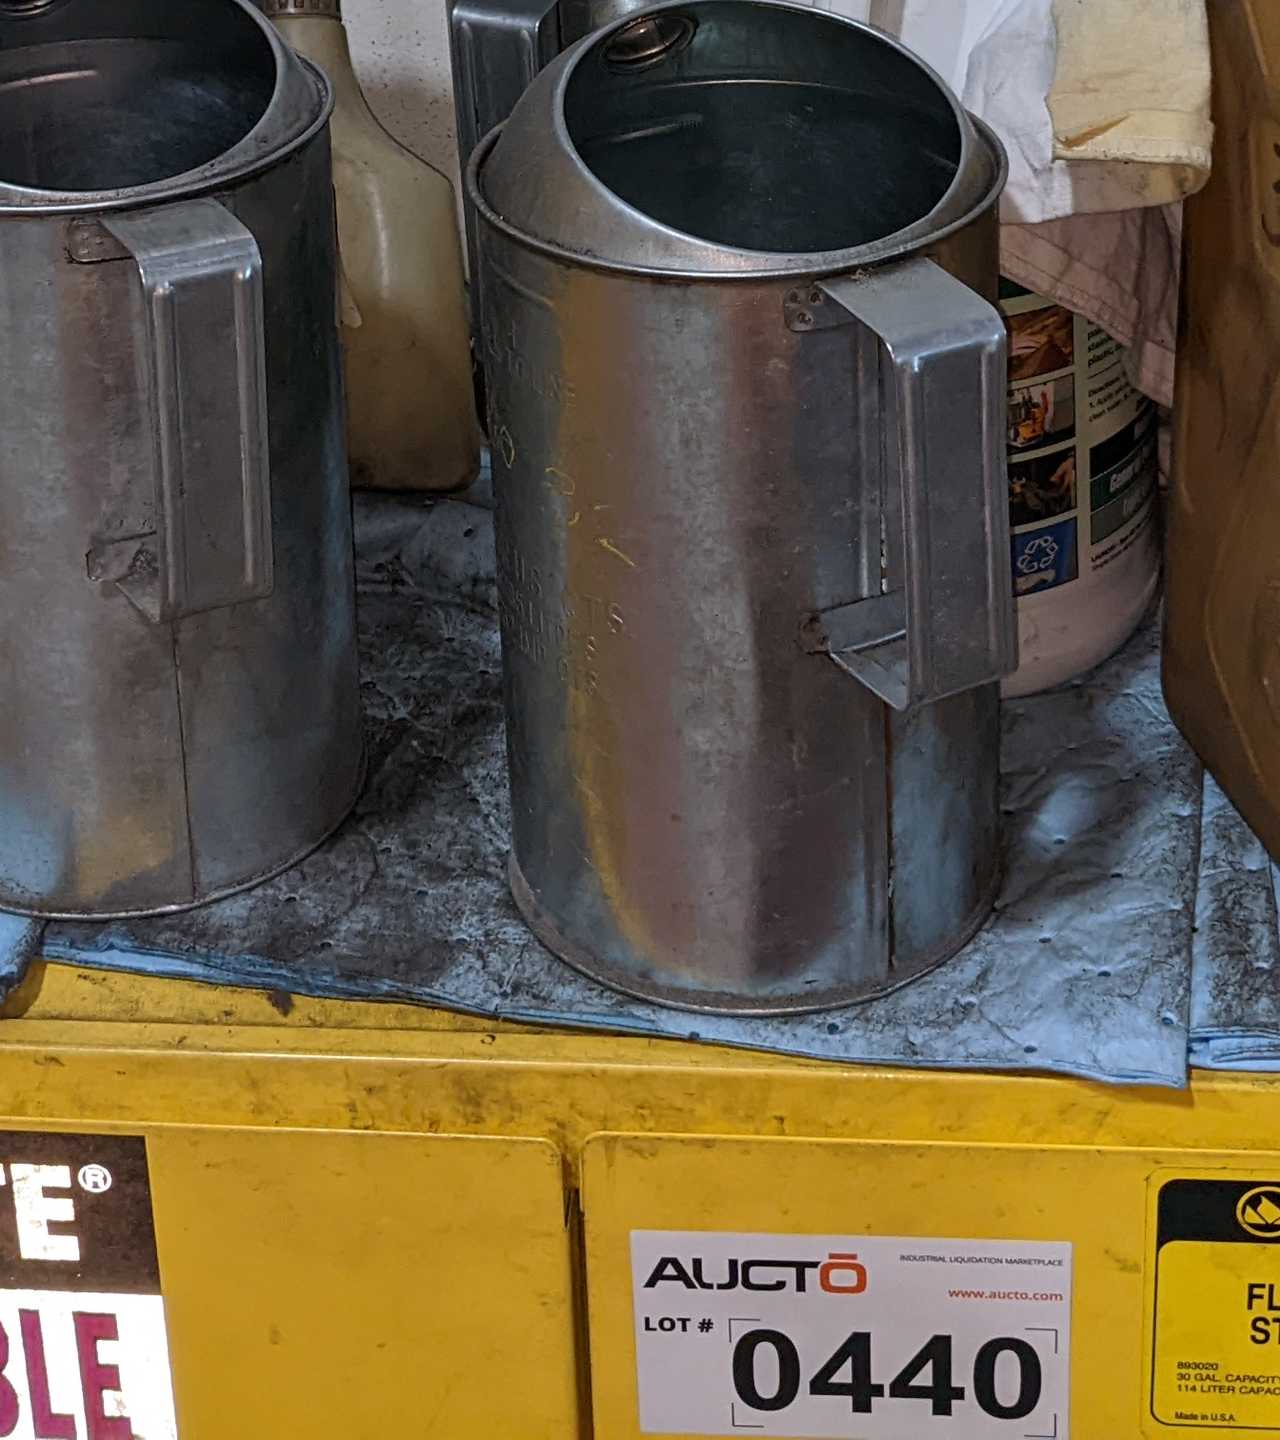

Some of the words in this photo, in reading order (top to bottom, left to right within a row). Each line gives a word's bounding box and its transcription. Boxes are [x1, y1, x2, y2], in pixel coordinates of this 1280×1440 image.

[948, 1255, 1004, 1266] LIQUIDATION
[1005, 1257, 1064, 1268] MARKETPLACE
[947, 1288, 1064, 1303] www.aucto.com
[643, 1315, 692, 1334] LOT
[696, 1317, 715, 1334] #
[731, 1327, 1043, 1421] 0440
[1176, 1372, 1191, 1382] 30
[1176, 1384, 1197, 1393] 114
[1200, 1384, 1236, 1394] LITER
[1174, 1411, 1199, 1421] Made
[1200, 1412, 1210, 1421] in
